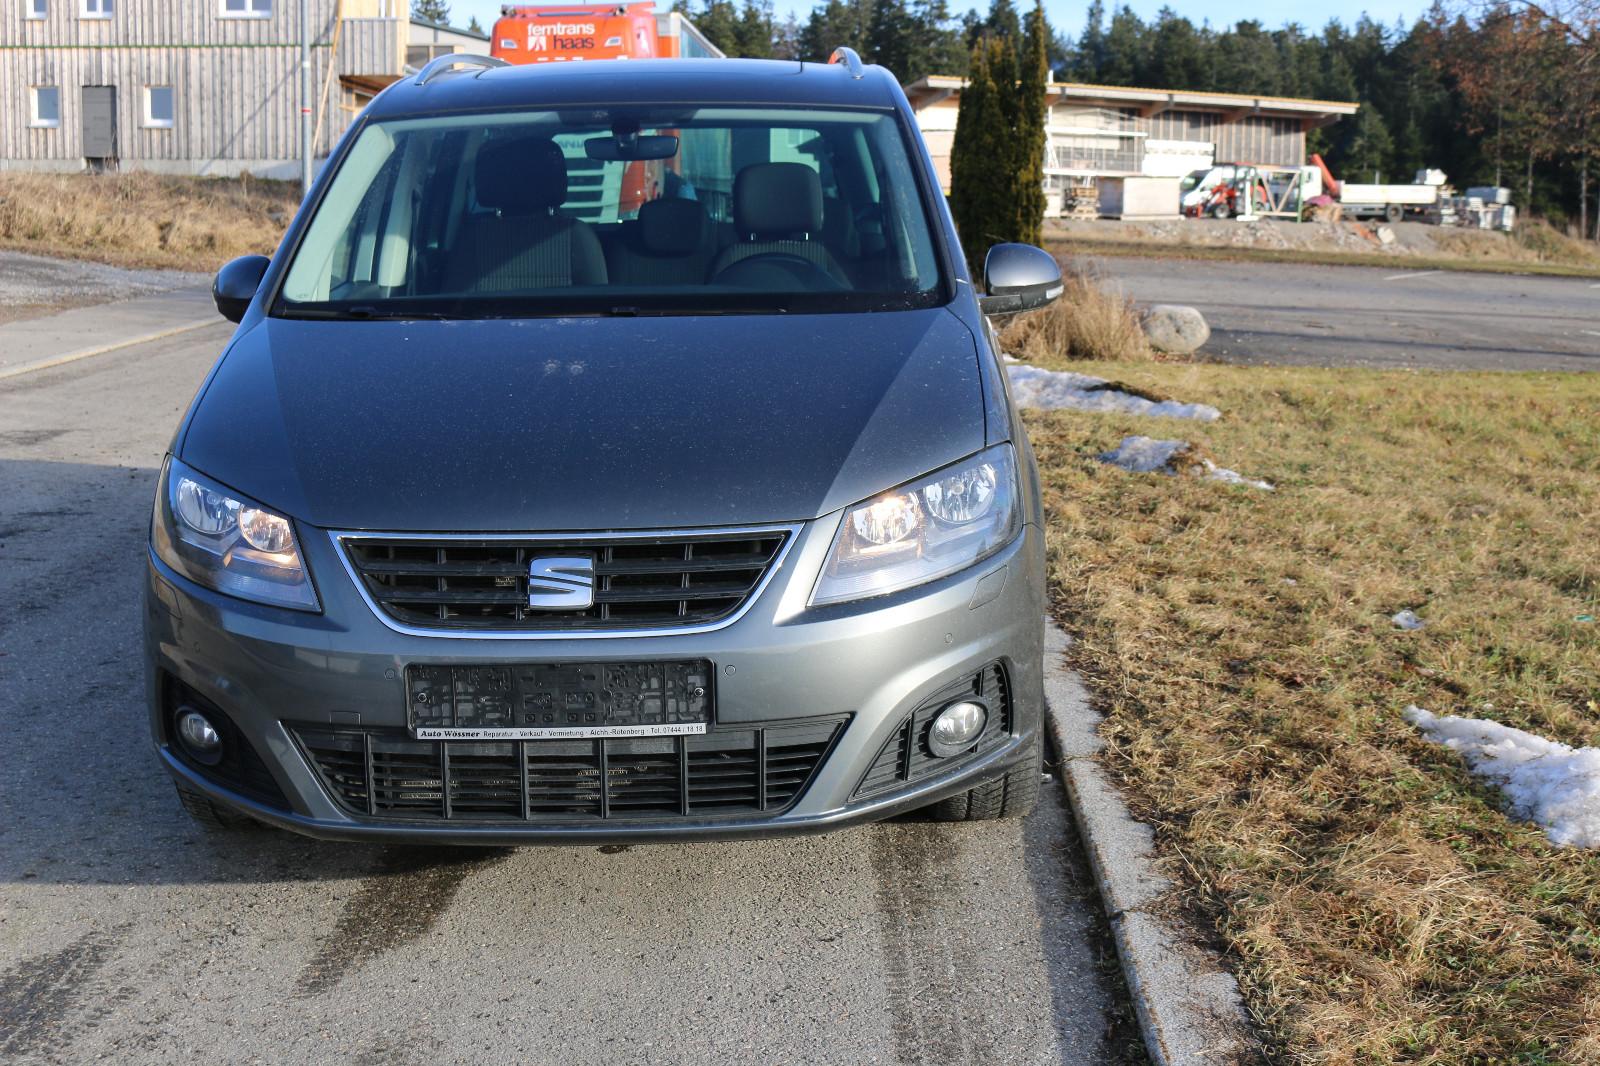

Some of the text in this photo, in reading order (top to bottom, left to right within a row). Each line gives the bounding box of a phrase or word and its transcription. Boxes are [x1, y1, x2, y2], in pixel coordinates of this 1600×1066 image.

[553, 35, 594, 49] haas
[420, 730, 442, 738] Auto
[444, 730, 480, 738] Wössner
[483, 731, 513, 739] Reparatur
[548, 729, 584, 738] Vermietung
